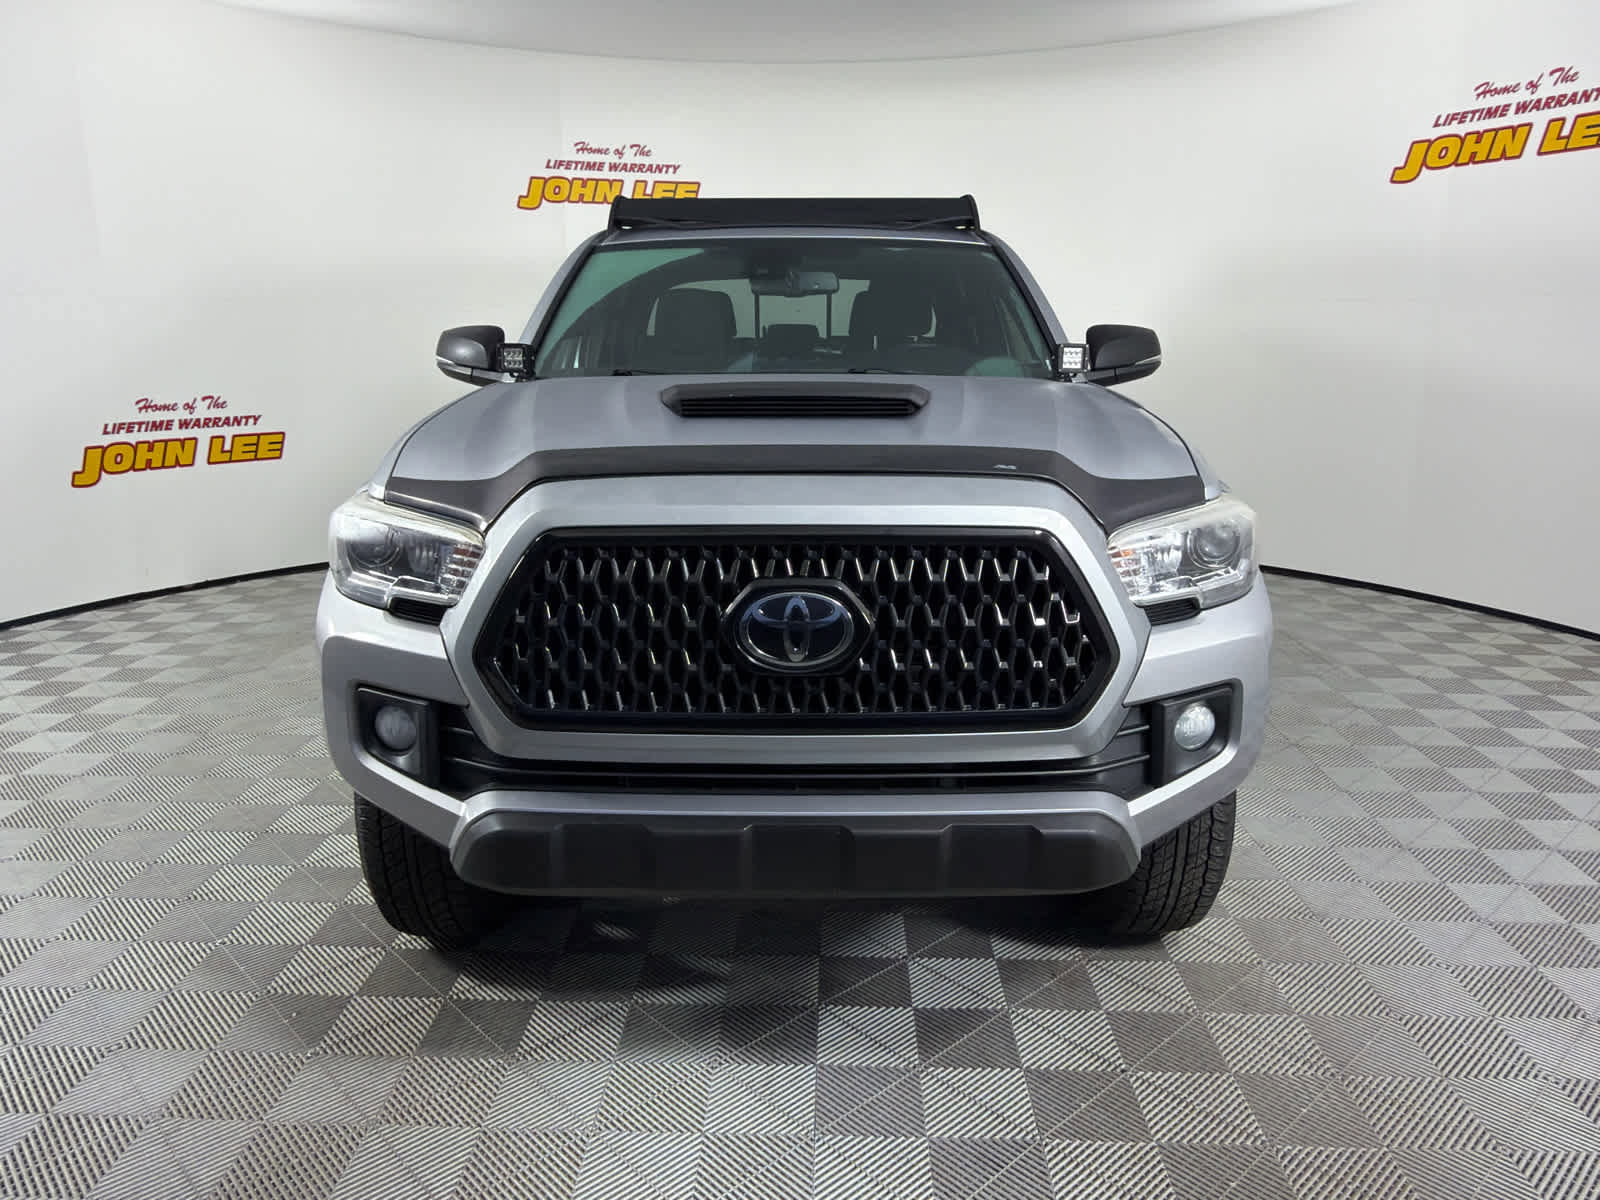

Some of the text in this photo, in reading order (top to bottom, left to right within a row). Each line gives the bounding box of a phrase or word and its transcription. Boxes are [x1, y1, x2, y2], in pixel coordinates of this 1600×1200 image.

[1474, 66, 1580, 100] Home of The
[1432, 87, 1600, 128] LIFETIME WARRANT
[574, 141, 652, 159] Home of The
[1390, 110, 1600, 184] JOHN LE
[545, 158, 680, 174] LIFETIME WARRANTY
[517, 176, 700, 210] JOHN LEE
[135, 395, 227, 415] Home of The
[102, 414, 262, 435] LIFETIME WARRANTY
[72, 431, 285, 488] JOHN LEE
